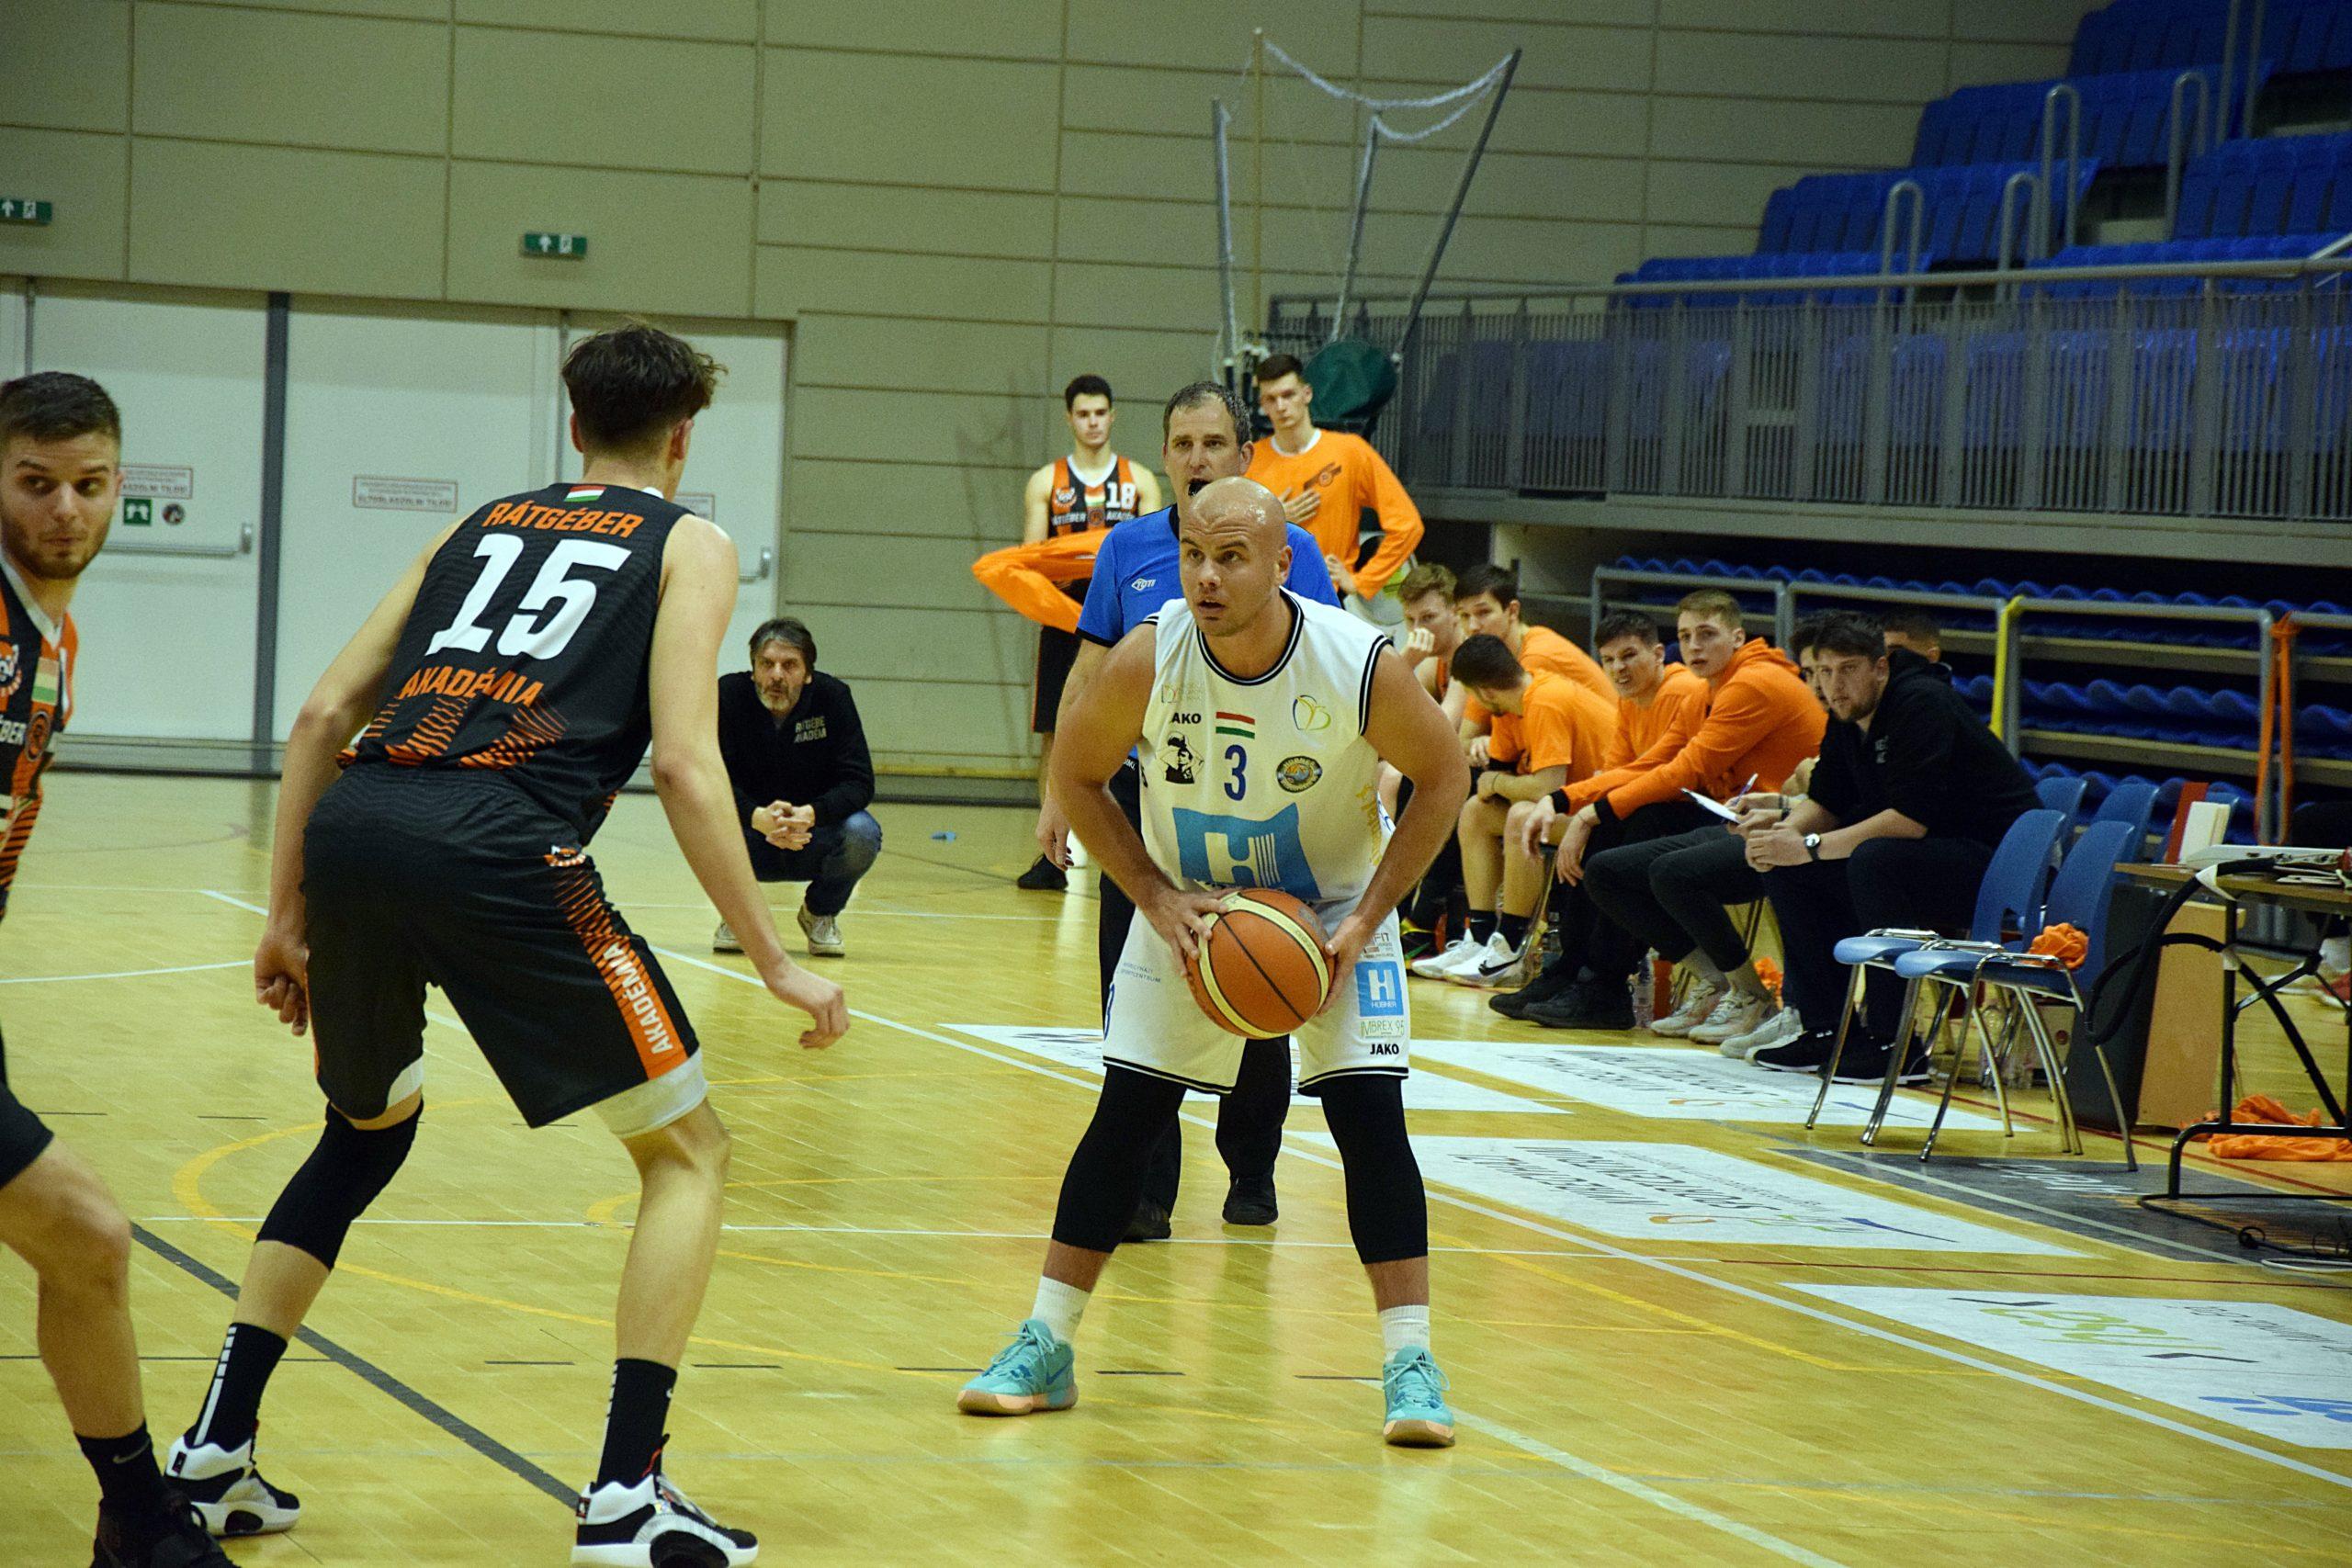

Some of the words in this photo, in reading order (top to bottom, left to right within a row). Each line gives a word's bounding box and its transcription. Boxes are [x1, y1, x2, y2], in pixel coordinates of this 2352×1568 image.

[482, 501, 644, 538] RÁTGÉBER
[1105, 481, 1136, 510] 18
[424, 533, 632, 660] 15
[399, 666, 544, 706] AKADÉMIA
[1224, 744, 1247, 801] 3
[603, 942, 673, 1055] AKADÉMIA
[1370, 1043, 1399, 1055] JAKO
[1514, 1146, 1781, 1211] SPORTCENTRUM
